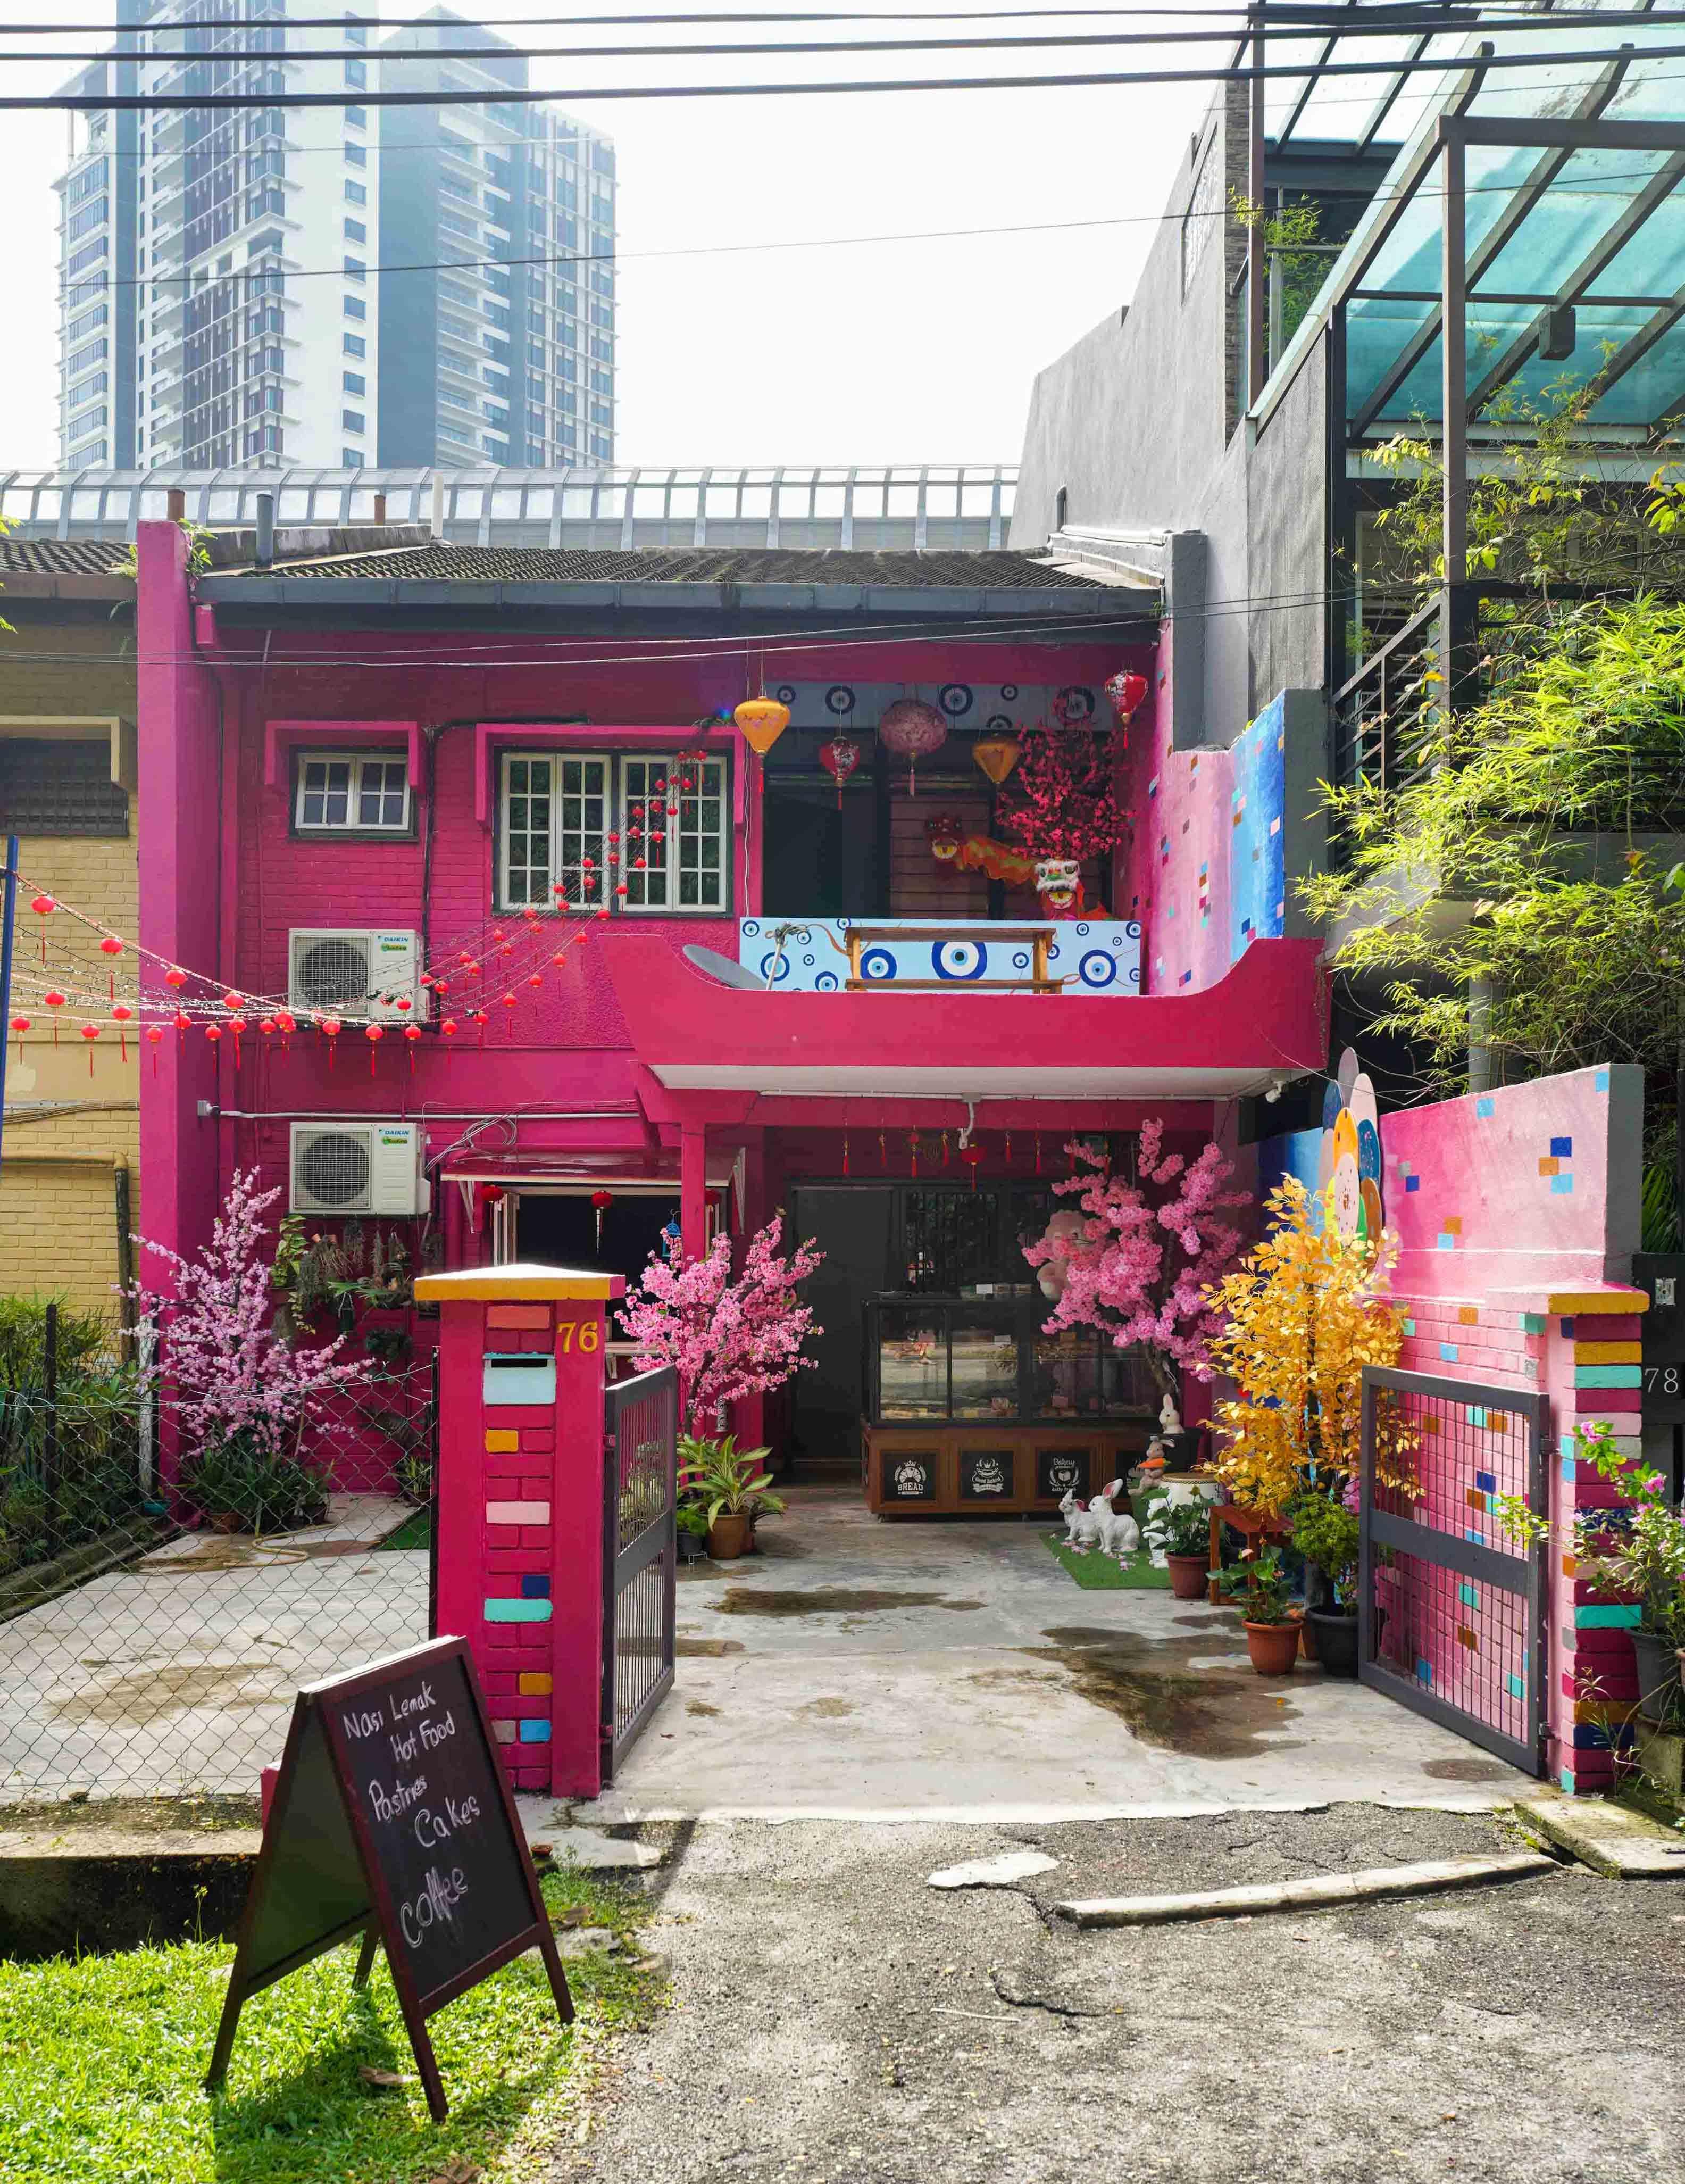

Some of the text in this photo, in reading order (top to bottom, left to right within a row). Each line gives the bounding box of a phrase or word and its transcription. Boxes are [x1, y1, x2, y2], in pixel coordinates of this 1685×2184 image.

[557, 1321, 598, 1353] 76
[1645, 1368, 1679, 1393] 78
[1053, 1458, 1075, 1468] Bakery
[897, 1482, 923, 1491] BREAD
[343, 1681, 436, 1739] Nasi Lemak
[390, 1710, 455, 1762] Hot Food
[400, 1866, 468, 1948] Coffee
